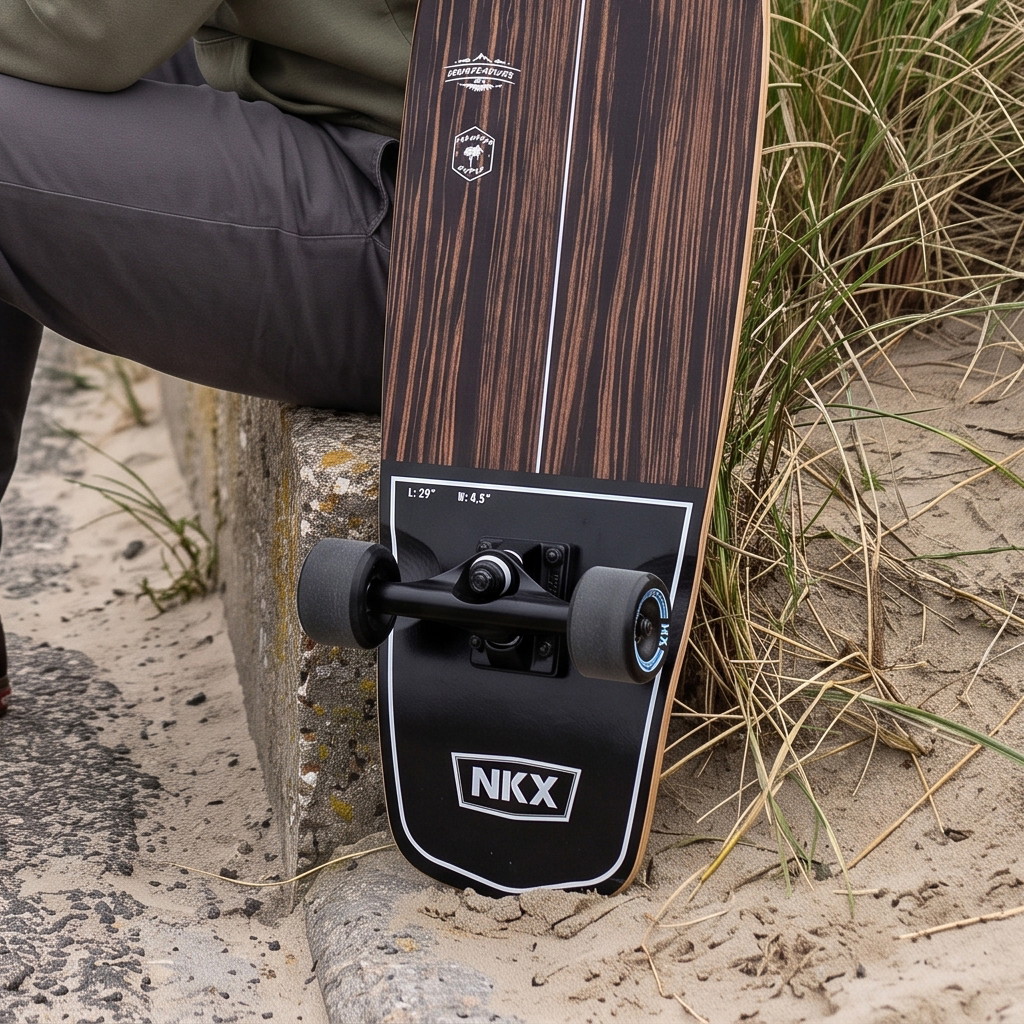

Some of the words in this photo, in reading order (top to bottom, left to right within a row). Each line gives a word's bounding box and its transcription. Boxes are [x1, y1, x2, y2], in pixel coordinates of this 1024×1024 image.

[408, 487, 416, 497] L:
[419, 488, 436, 499] 29"
[458, 492, 468, 502] W:
[471, 766, 558, 809] NKX
